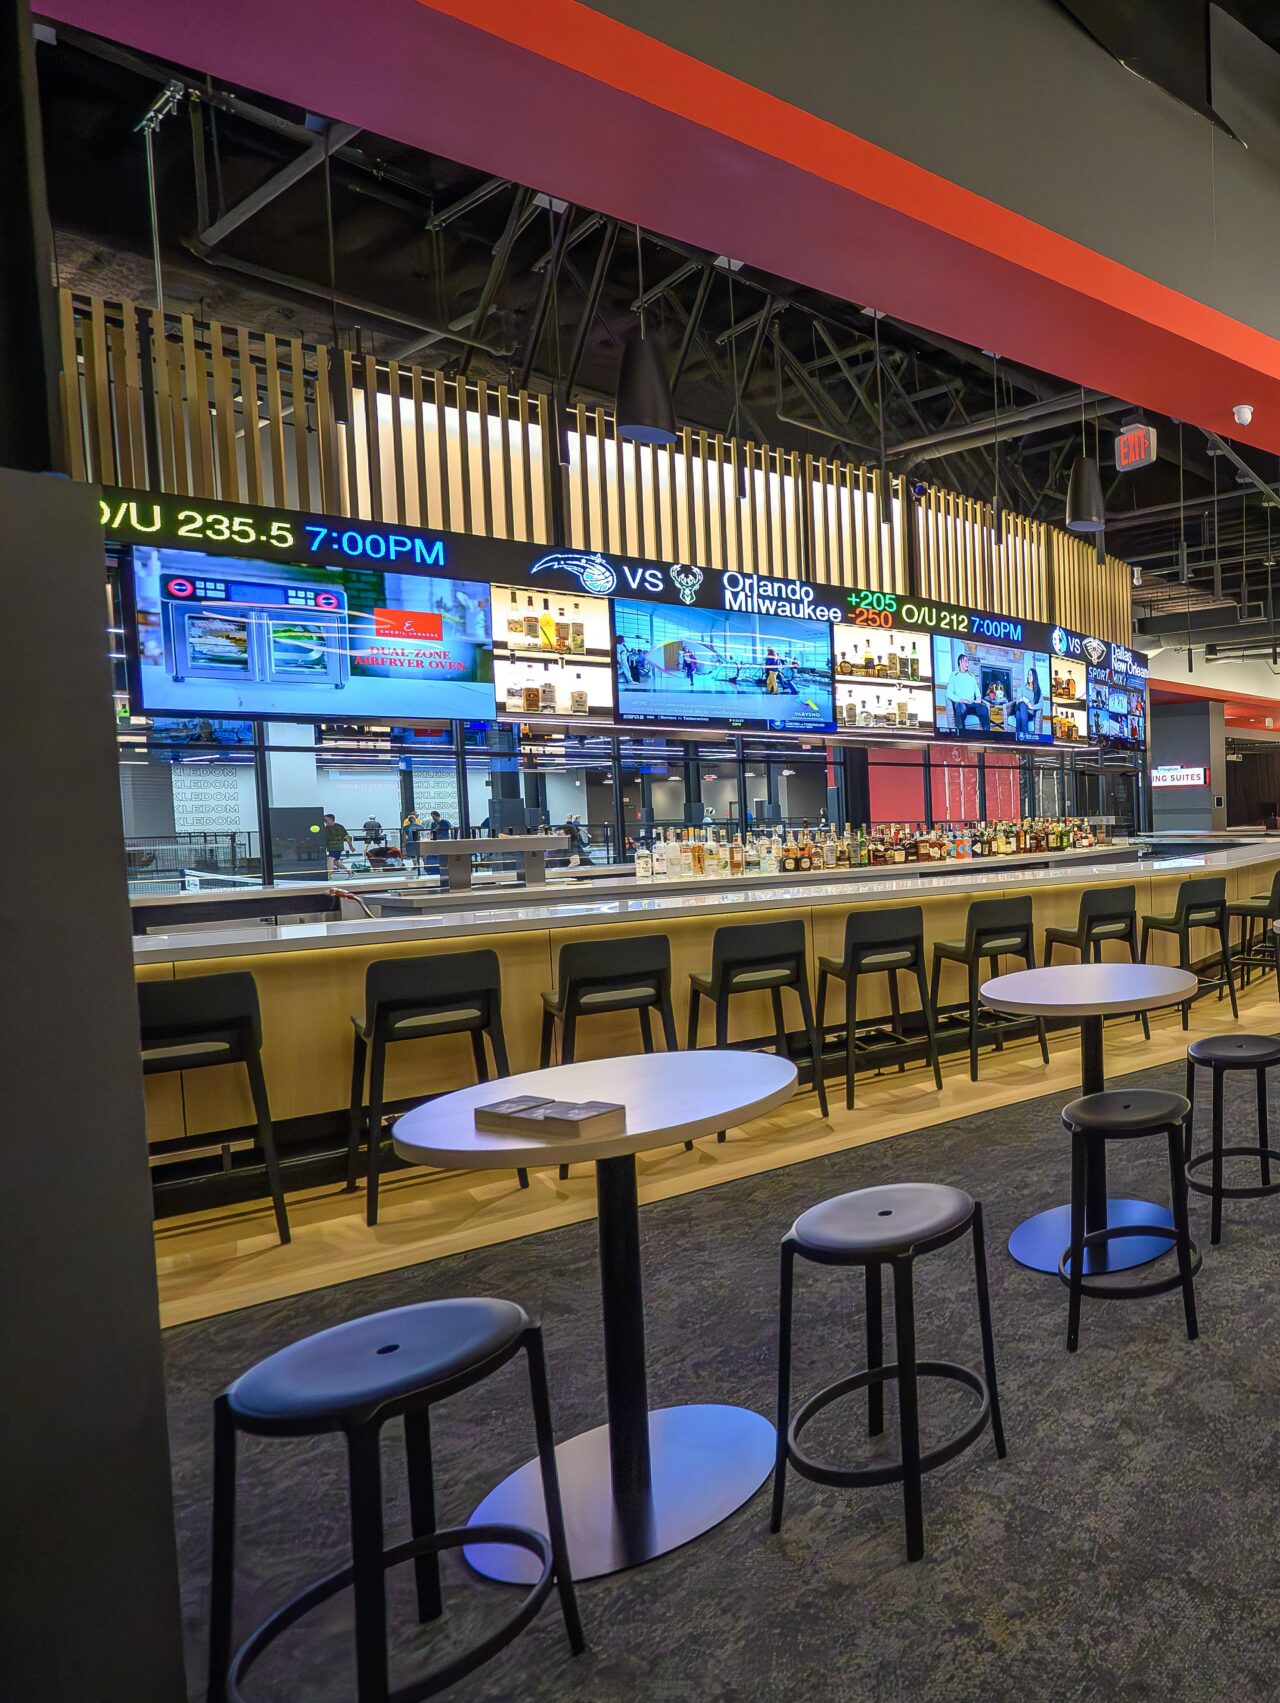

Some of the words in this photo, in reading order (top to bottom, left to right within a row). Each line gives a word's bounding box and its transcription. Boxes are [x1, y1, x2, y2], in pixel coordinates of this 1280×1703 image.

[1120, 429, 1146, 465] EXIT
[177, 510, 294, 548] 235.5
[305, 526, 445, 566] 7:00PM
[622, 566, 664, 592] VS
[723, 571, 814, 601] Orlando
[725, 590, 842, 622] Milwaukee
[847, 591, 897, 612] +205
[848, 607, 893, 628] -250
[902, 604, 937, 627] O/U
[940, 611, 968, 632] 212
[970, 617, 1022, 641] 7:00PM
[369, 646, 451, 660] DUAL-ZONE
[1068, 637, 1081, 654] VS
[1111, 643, 1132, 662] Dallas
[354, 656, 425, 669] AIRFRYER
[428, 660, 465, 671] OVEN
[1111, 659, 1127, 673] New
[1170, 774, 1202, 782] SUITES
